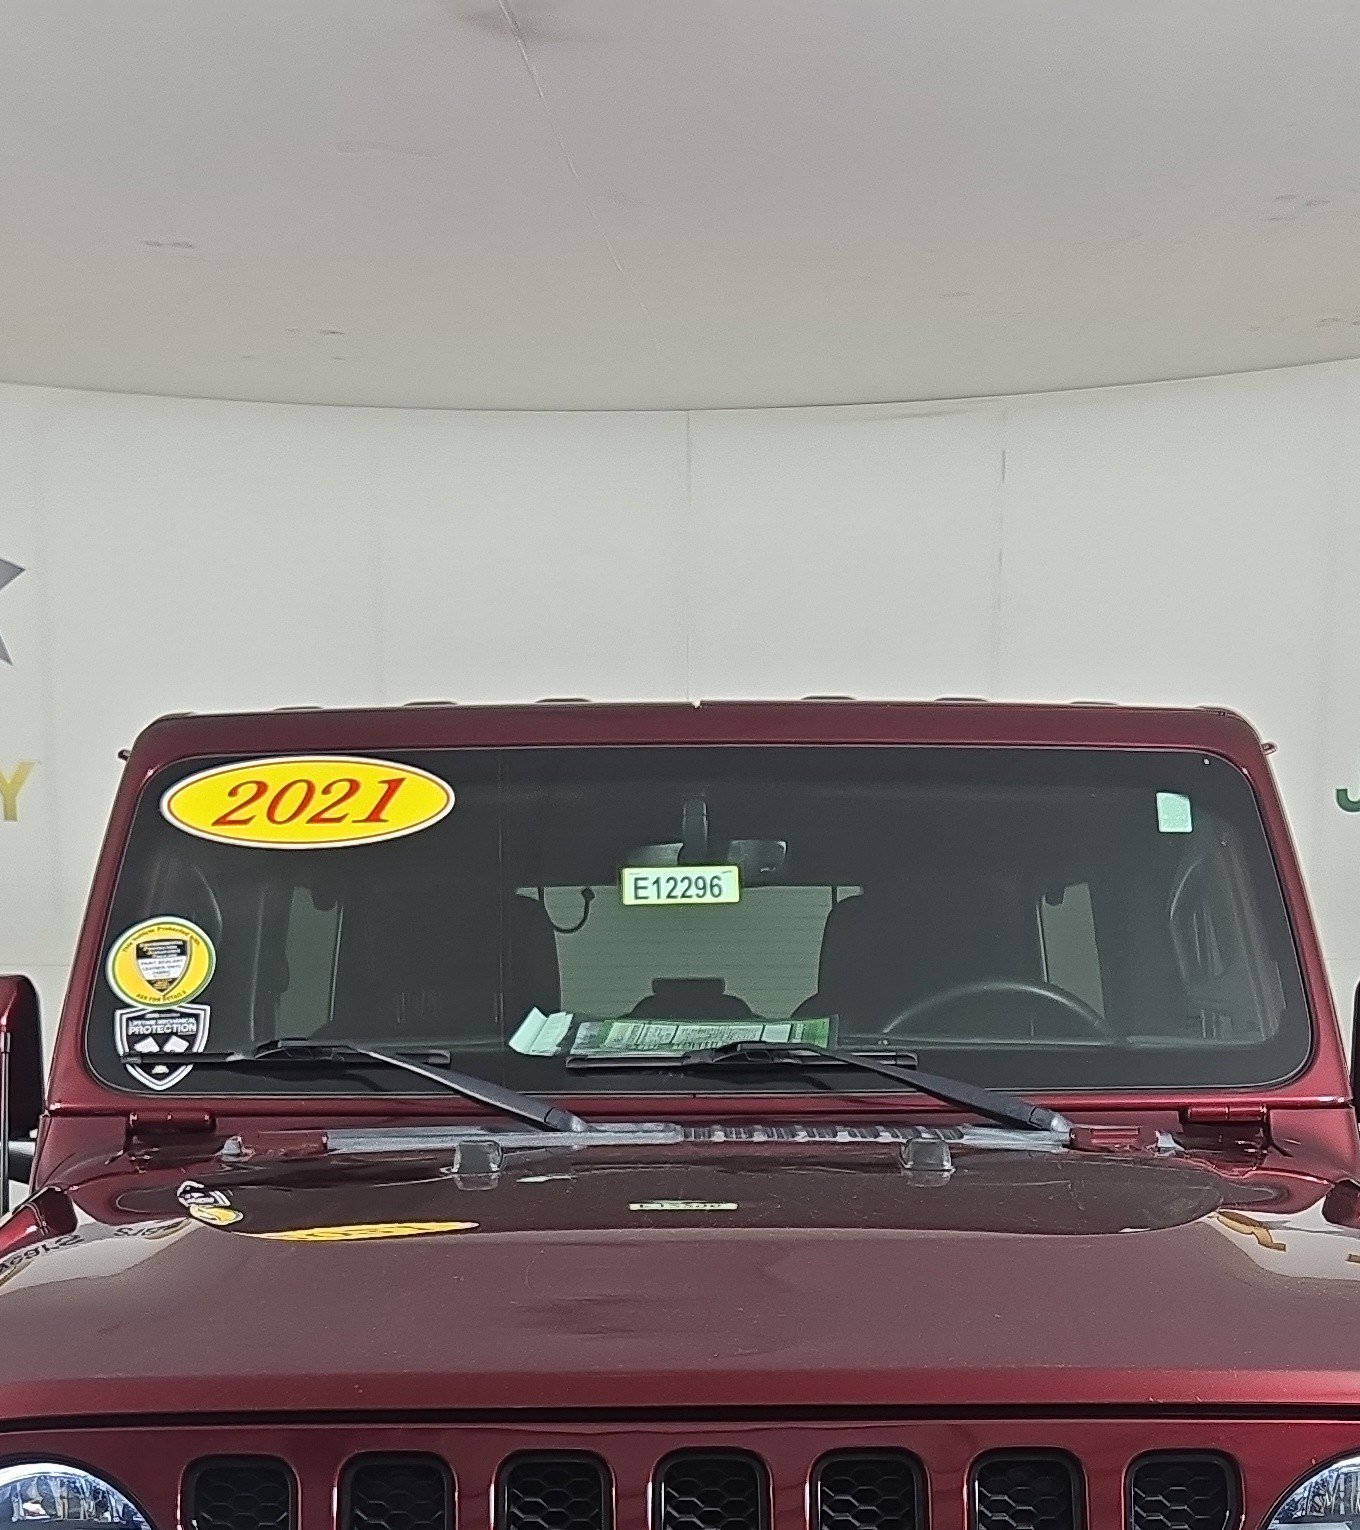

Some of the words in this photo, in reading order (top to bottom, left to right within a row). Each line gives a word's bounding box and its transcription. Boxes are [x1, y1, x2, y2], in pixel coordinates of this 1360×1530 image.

[211, 776, 407, 828] 2021
[633, 874, 723, 901] E12296
[127, 1023, 197, 1036] PROTECTION
